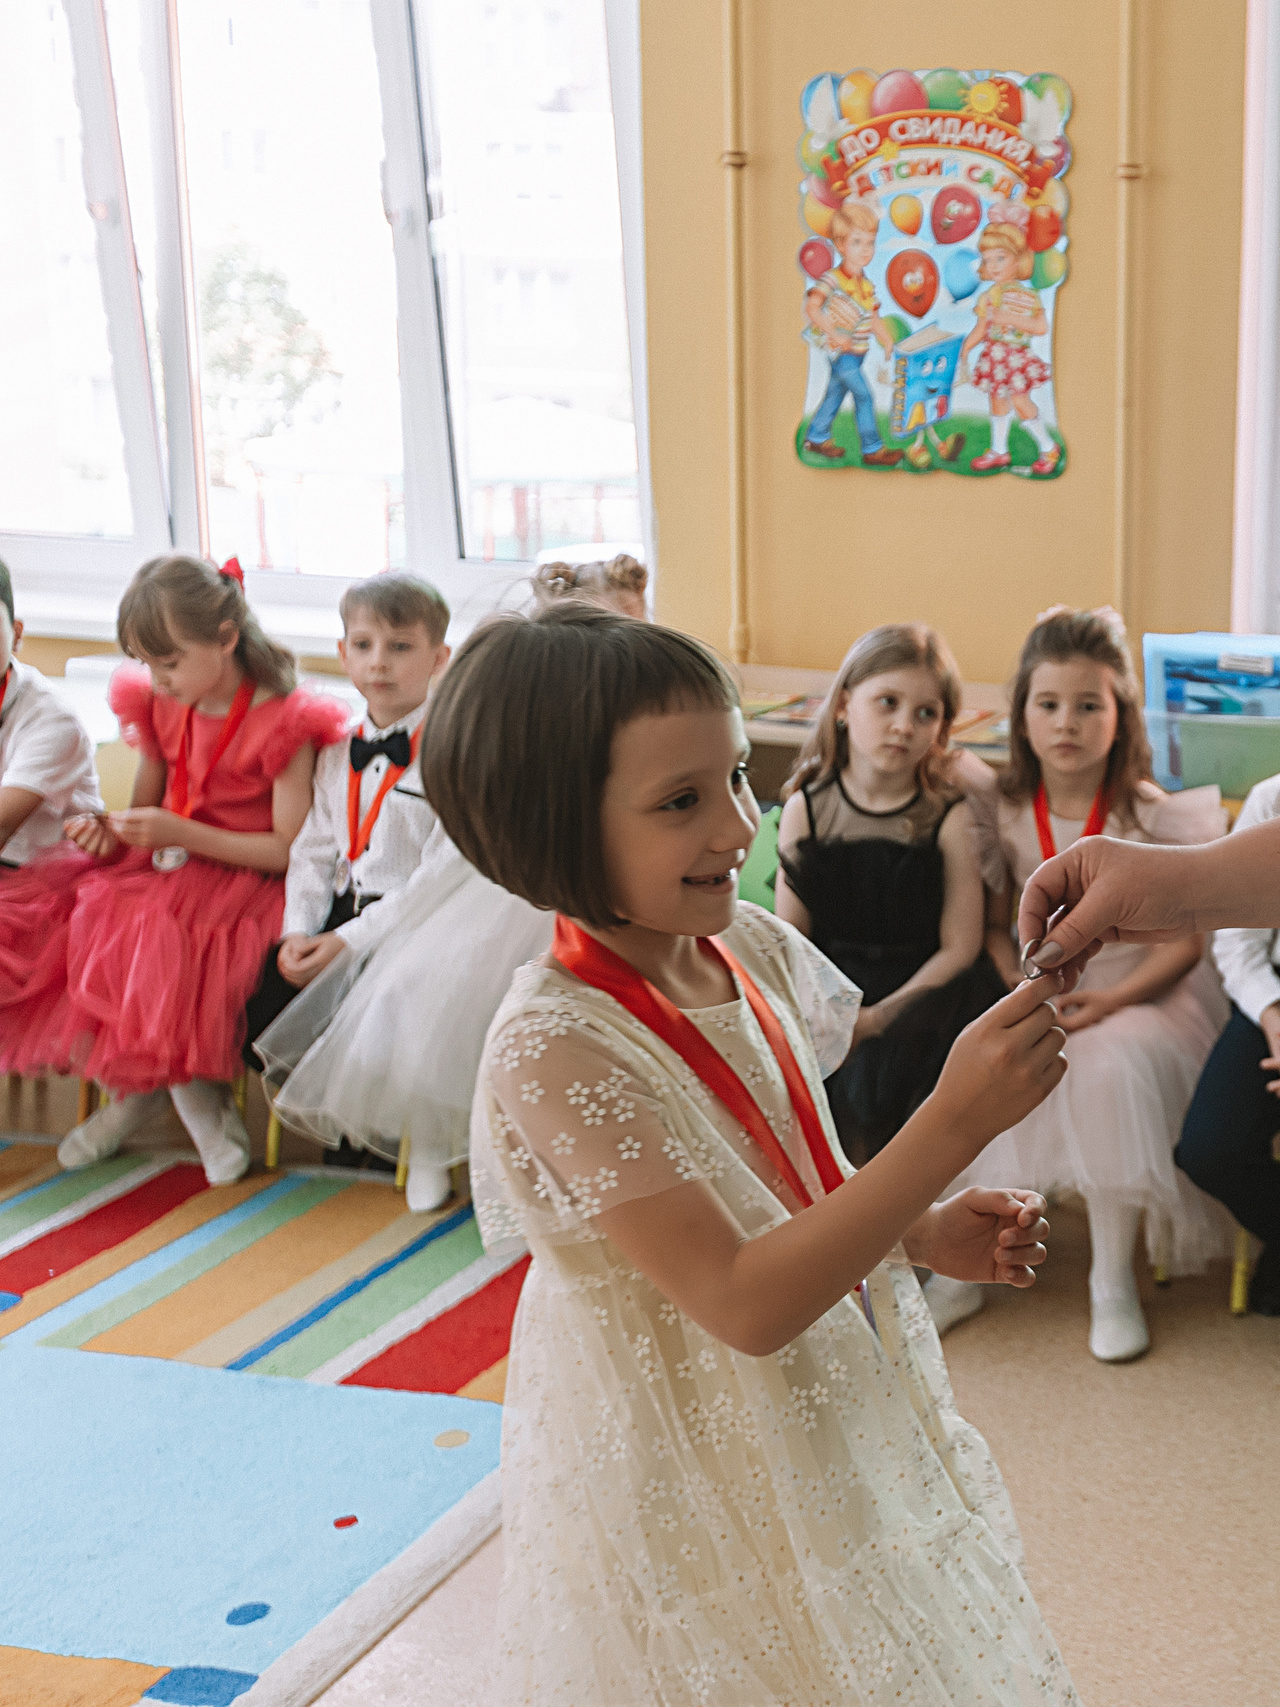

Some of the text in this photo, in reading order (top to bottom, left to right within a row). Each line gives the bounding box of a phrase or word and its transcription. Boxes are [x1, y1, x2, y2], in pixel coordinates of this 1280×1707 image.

[839, 117, 1032, 168] ДО СВИДАНИЯ,
[855, 158, 1023, 199] ДЕТСКИЙ САД!
